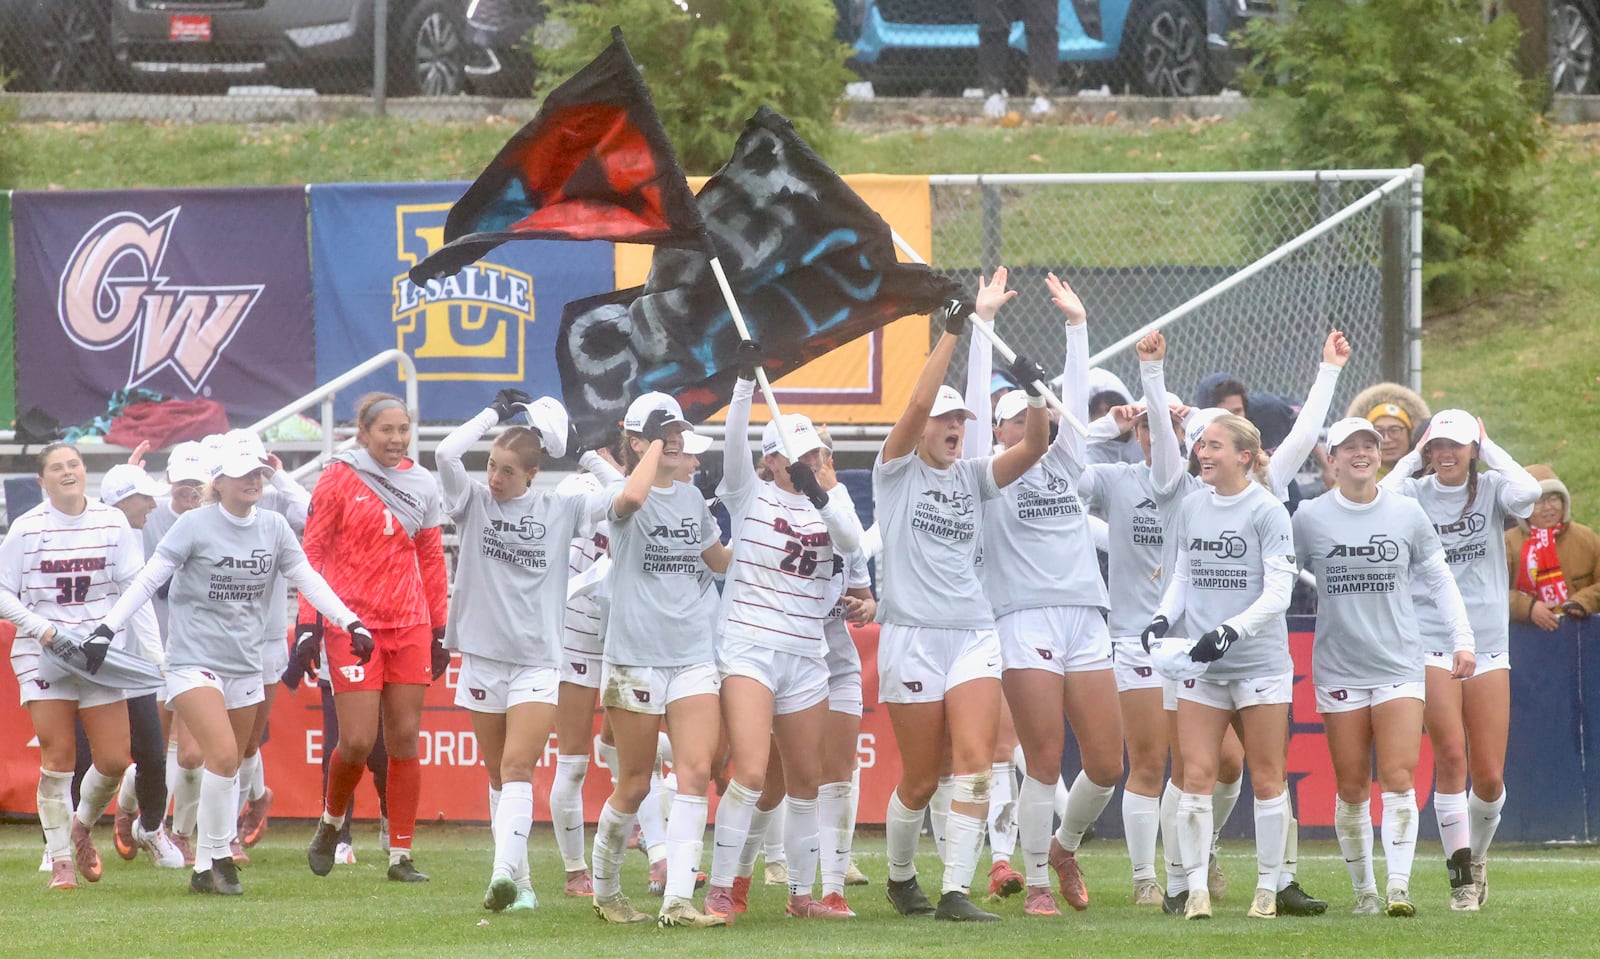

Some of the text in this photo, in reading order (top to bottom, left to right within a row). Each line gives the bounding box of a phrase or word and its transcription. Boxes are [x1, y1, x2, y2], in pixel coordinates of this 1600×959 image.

[58, 205, 266, 394] GW
[1057, 495, 1077, 505] SOCC
[914, 509, 953, 527] WOMEN'S
[645, 543, 669, 554] 2025
[1325, 534, 1400, 564] A10 50
[644, 553, 682, 562] WOMEN'S
[780, 541, 818, 577] 26
[1444, 548, 1486, 563] MPIONS
[642, 562, 696, 574] CHAMPIO
[1215, 569, 1248, 578] SOCCER
[1325, 565, 1348, 575] 2025
[210, 574, 233, 583] 2025
[1326, 574, 1366, 583] WOMEN'S
[210, 582, 246, 591] WOMEN'S
[1327, 581, 1395, 595] CHAMPIONS
[208, 590, 265, 601] CHAMPI
